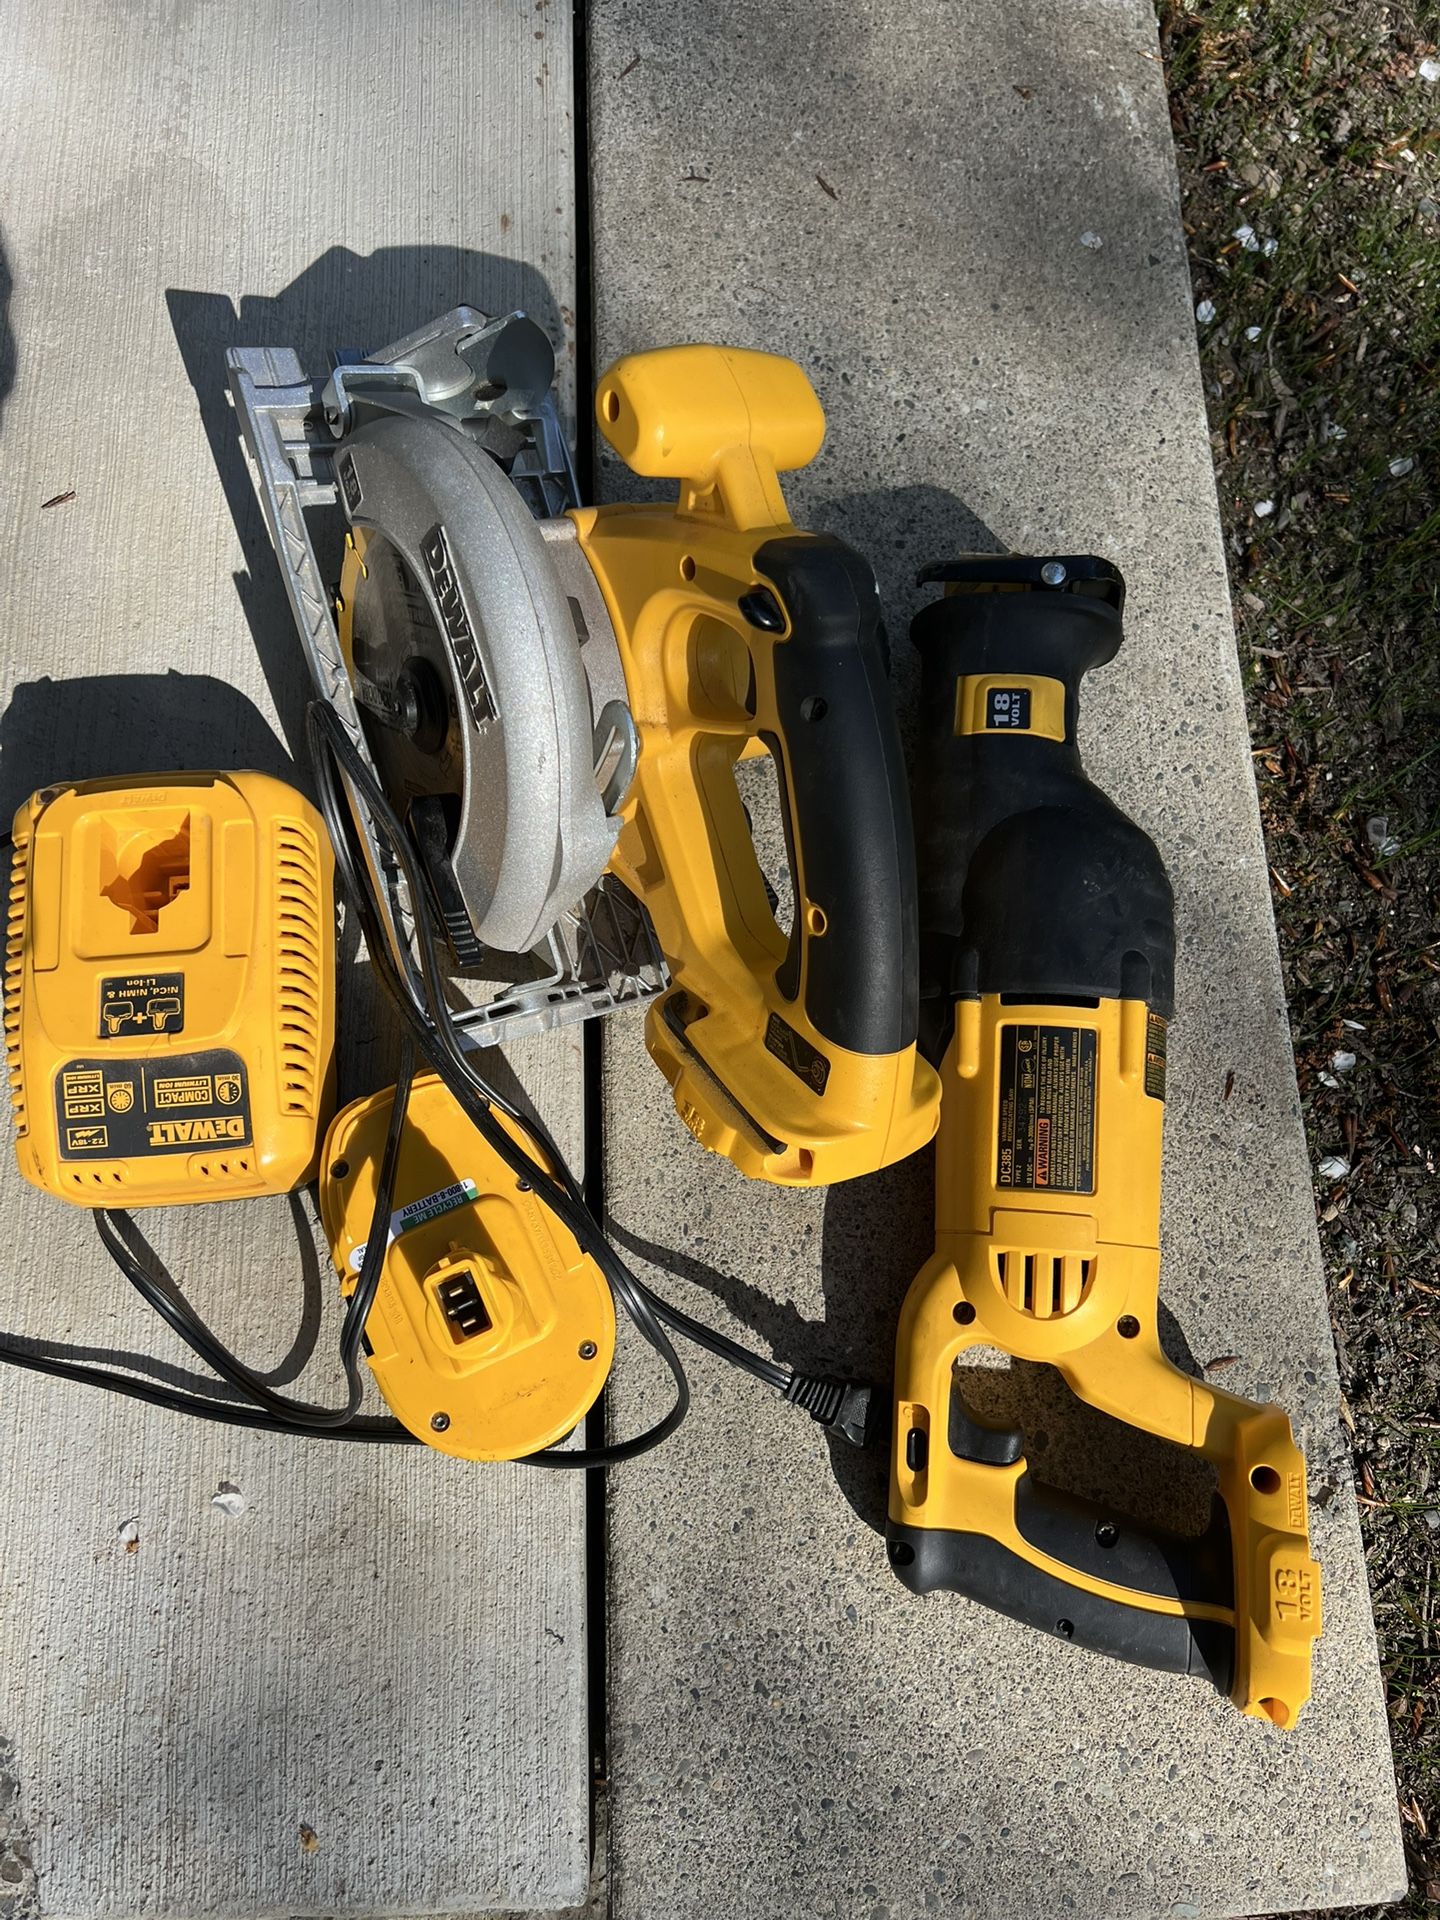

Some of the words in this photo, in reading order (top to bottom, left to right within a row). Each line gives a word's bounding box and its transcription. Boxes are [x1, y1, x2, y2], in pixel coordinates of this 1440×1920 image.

[423, 530, 496, 732] DEWALT
[994, 693, 1010, 726] 18
[1012, 693, 1020, 726] VOLT
[119, 989, 148, 997] NiMH
[150, 986, 178, 994] NiCd,
[68, 1085, 99, 1093] XRP
[1023, 1074, 1033, 1088] NOM
[69, 1104, 100, 1113] XRP
[159, 1090, 208, 1104] COMPACT
[72, 1138, 104, 1146] 7.2-18V
[1038, 1122, 1048, 1169] WARNING
[1070, 1130, 1075, 1138] OR
[1001, 1149, 1011, 1182] DC385
[402, 1182, 468, 1217] 1-800-8-BATTERY
[427, 1195, 463, 1218] RECYCLE
[413, 1209, 427, 1224] ME
[1288, 1473, 1303, 1527] DEWALT
[1274, 1568, 1299, 1621] 18
[1299, 1569, 1312, 1622] VOLT
